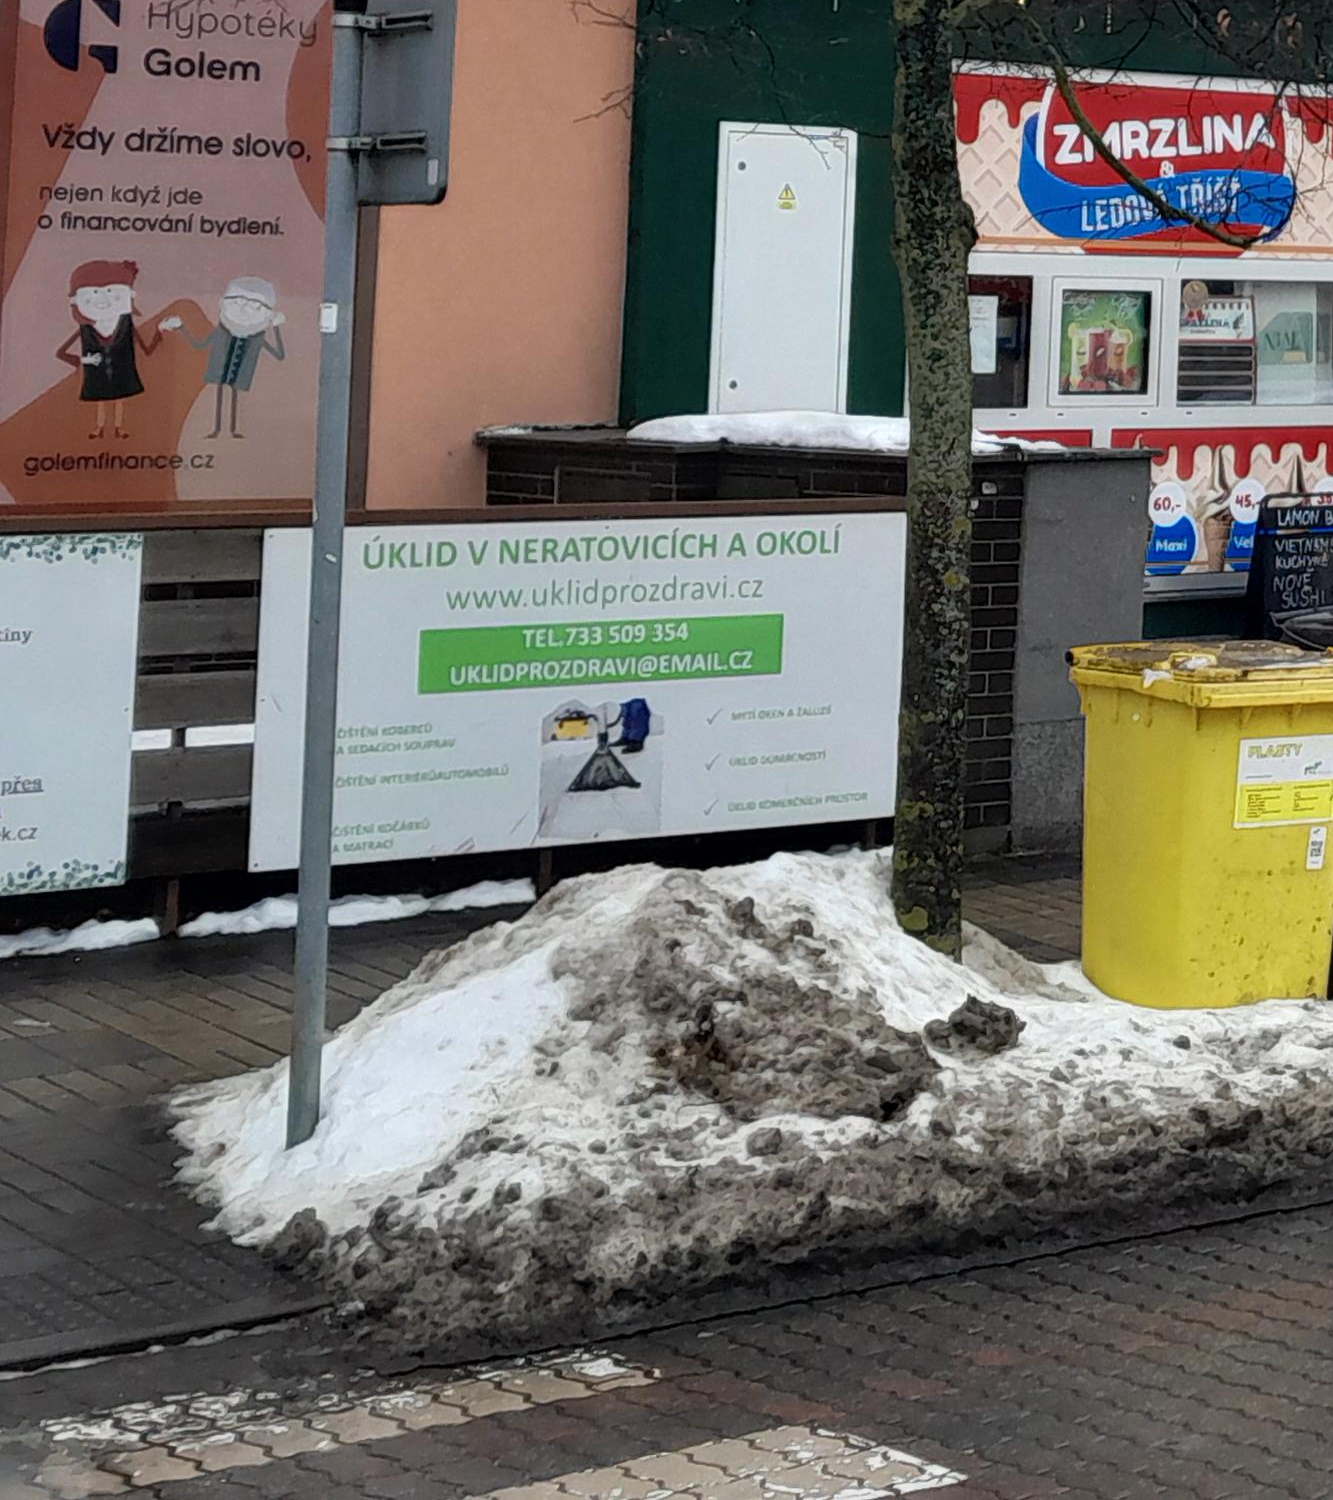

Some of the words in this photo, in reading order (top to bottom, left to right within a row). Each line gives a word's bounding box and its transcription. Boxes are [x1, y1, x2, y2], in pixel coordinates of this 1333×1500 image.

[147, 1, 318, 48] Hypotéky
[143, 48, 261, 82] Golem
[42, 122, 115, 156] Vždy
[124, 127, 223, 156] držíme
[232, 132, 312, 163] slovo,
[1052, 113, 1276, 165] ZMRZLINA
[1159, 160, 1176, 179] &
[39, 185, 104, 205] nejen
[111, 184, 161, 207] když
[166, 186, 203, 208] jde
[37, 214, 53, 229] o
[60, 211, 194, 234] financování
[200, 215, 285, 238] bydlení.
[23, 452, 215, 477] golemfinance.cz
[1152, 496, 1182, 513] 60,-
[1234, 493, 1261, 510] 45,-
[1276, 508, 1320, 527] LAMON
[362, 535, 458, 570] ÚKLID
[467, 539, 489, 566] V
[499, 527, 718, 564] NERATOVICÍCH
[726, 532, 747, 557] A
[756, 523, 843, 557] OKOLÍ
[1155, 538, 1188, 553] Maxi
[1232, 535, 1255, 550] Vel
[446, 575, 764, 610] www.uklidprozdravi.cz
[521, 626, 602, 649] TEL.733
[608, 624, 646, 645] 509
[651, 622, 689, 643] 354
[450, 650, 753, 686] UKLIDPROZDRAVI@EMAIL.CZ
[335, 745, 345, 755] A
[0, 826, 38, 842] k.cz
[332, 843, 340, 853] A
